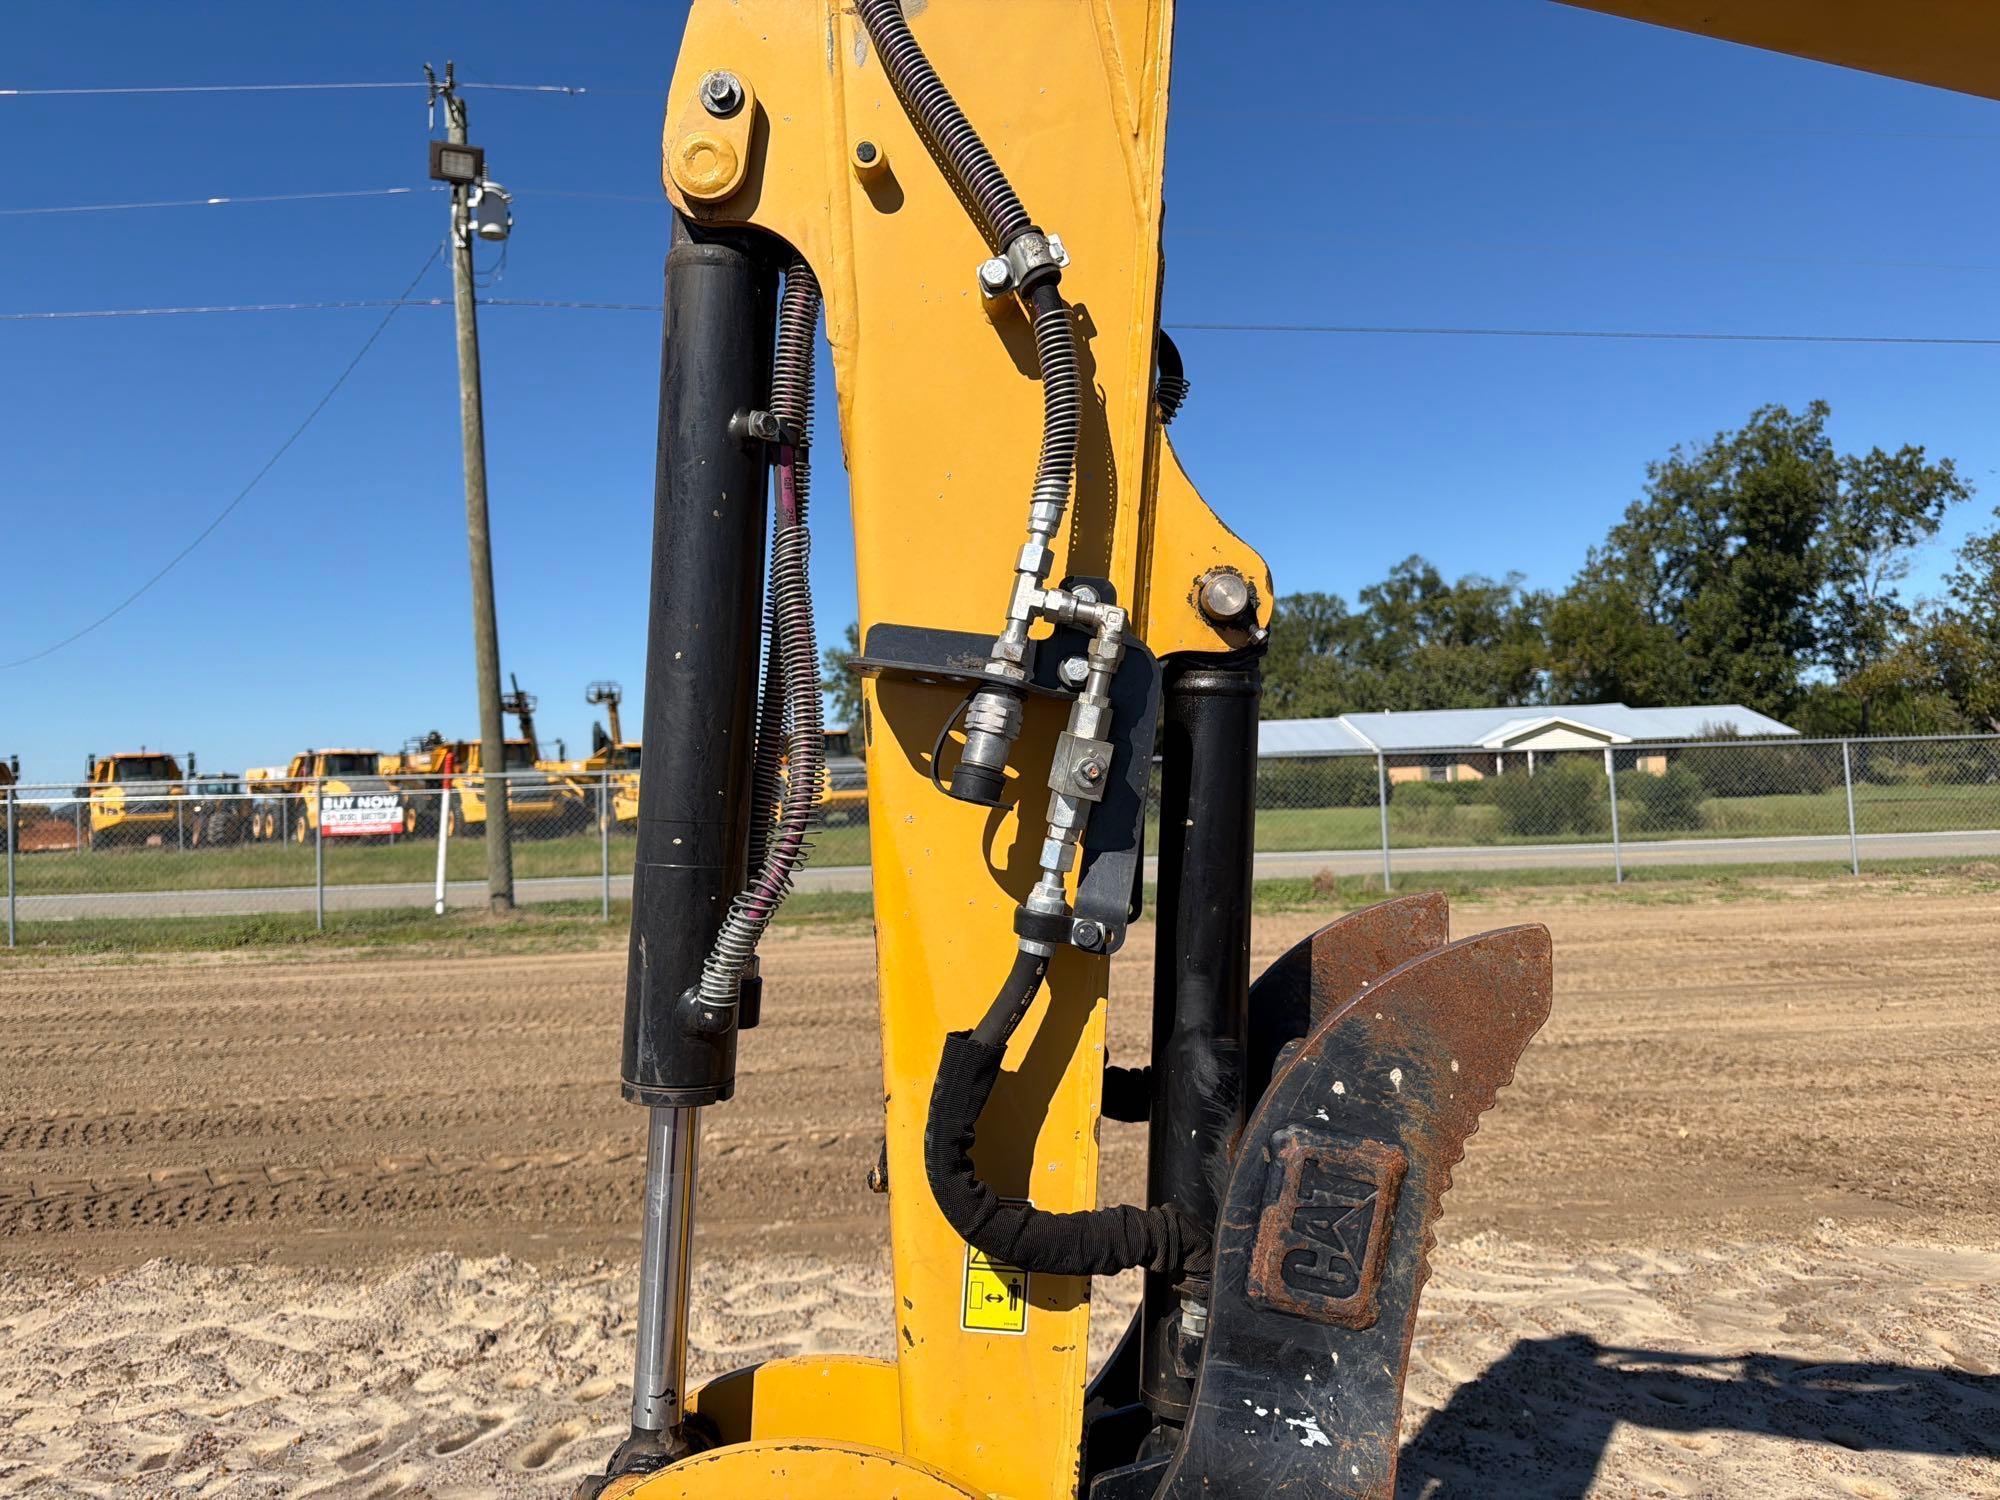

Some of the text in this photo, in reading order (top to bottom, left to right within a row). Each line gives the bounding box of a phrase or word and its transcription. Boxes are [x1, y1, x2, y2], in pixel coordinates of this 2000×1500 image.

[323, 795, 398, 810] BUY NOW
[1282, 1159, 1378, 1300] CAT
